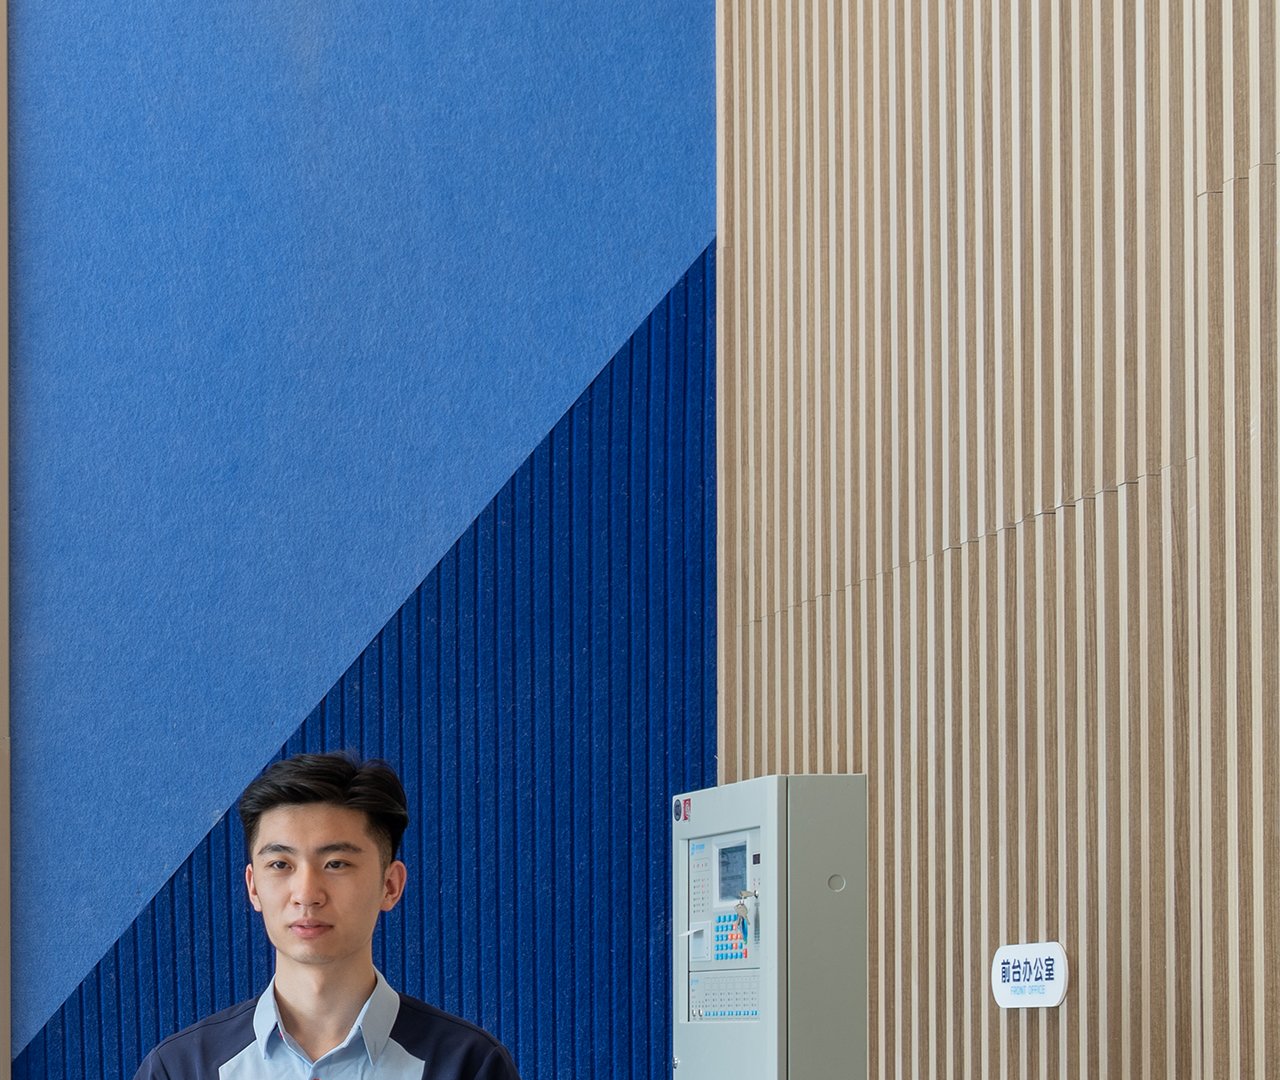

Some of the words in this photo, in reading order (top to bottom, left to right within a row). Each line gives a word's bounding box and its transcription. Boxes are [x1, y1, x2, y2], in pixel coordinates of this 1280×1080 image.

[1001, 956, 1055, 983] 前台办公室
